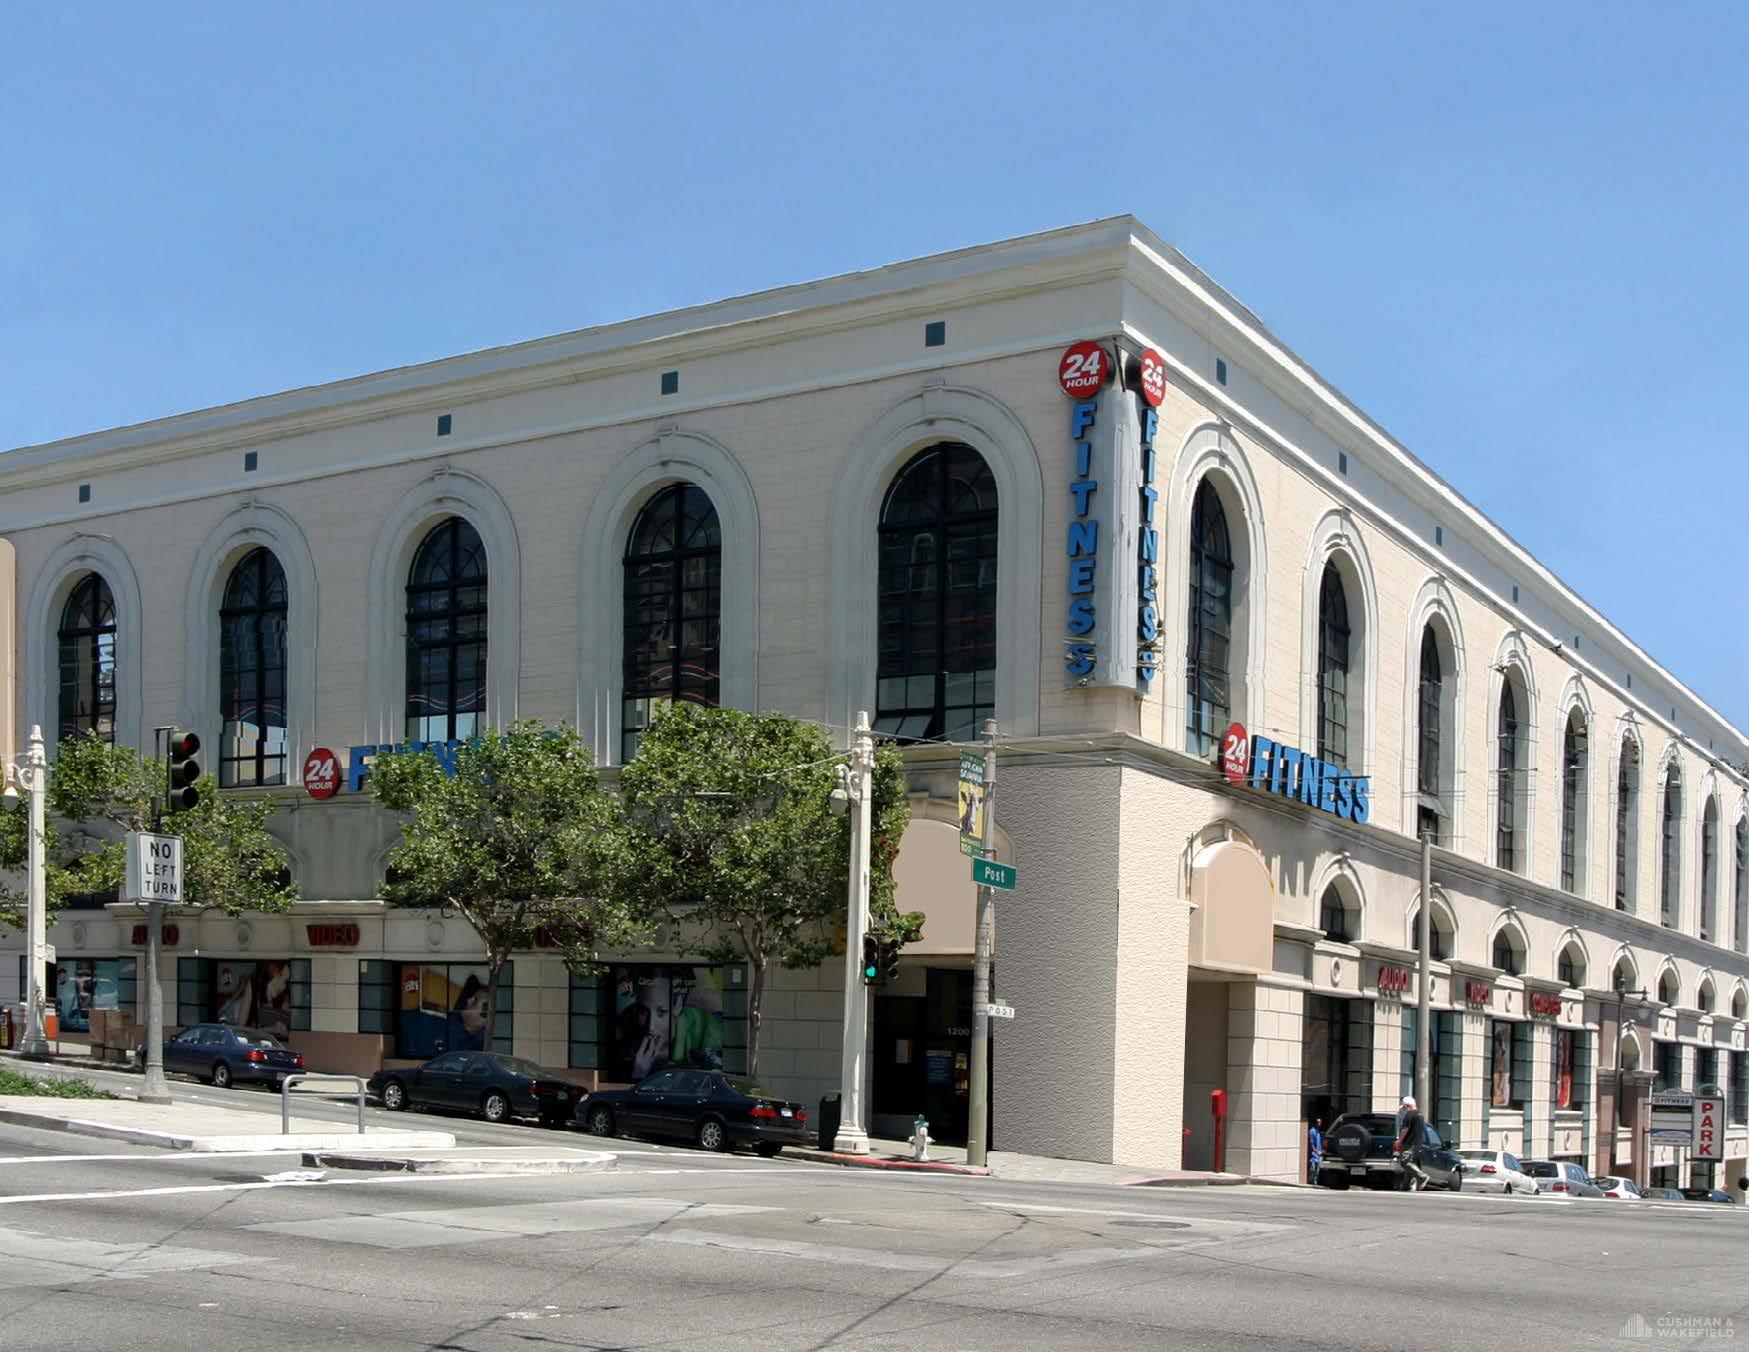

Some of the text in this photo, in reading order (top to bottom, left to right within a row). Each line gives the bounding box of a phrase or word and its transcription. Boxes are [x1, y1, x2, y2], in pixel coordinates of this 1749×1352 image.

[1062, 350, 1101, 380] 24
[1142, 358, 1163, 388] 24
[1066, 376, 1099, 389] HOUR
[1067, 402, 1097, 676] FITNESS
[1139, 408, 1158, 680] FITNESS
[1224, 734, 1247, 764] 24
[305, 759, 334, 781] 24
[1225, 761, 1244, 774] HOUR
[308, 781, 333, 791] HOUR
[1252, 735, 1369, 825] FITNESS
[150, 842, 171, 859] NO
[145, 864, 176, 878] LEFT
[984, 866, 1005, 883] Post
[145, 880, 177, 895] TURN
[306, 924, 361, 946] VIDEO
[1378, 967, 1408, 991] AUDIO
[1699, 1102, 1714, 1156] PARK
